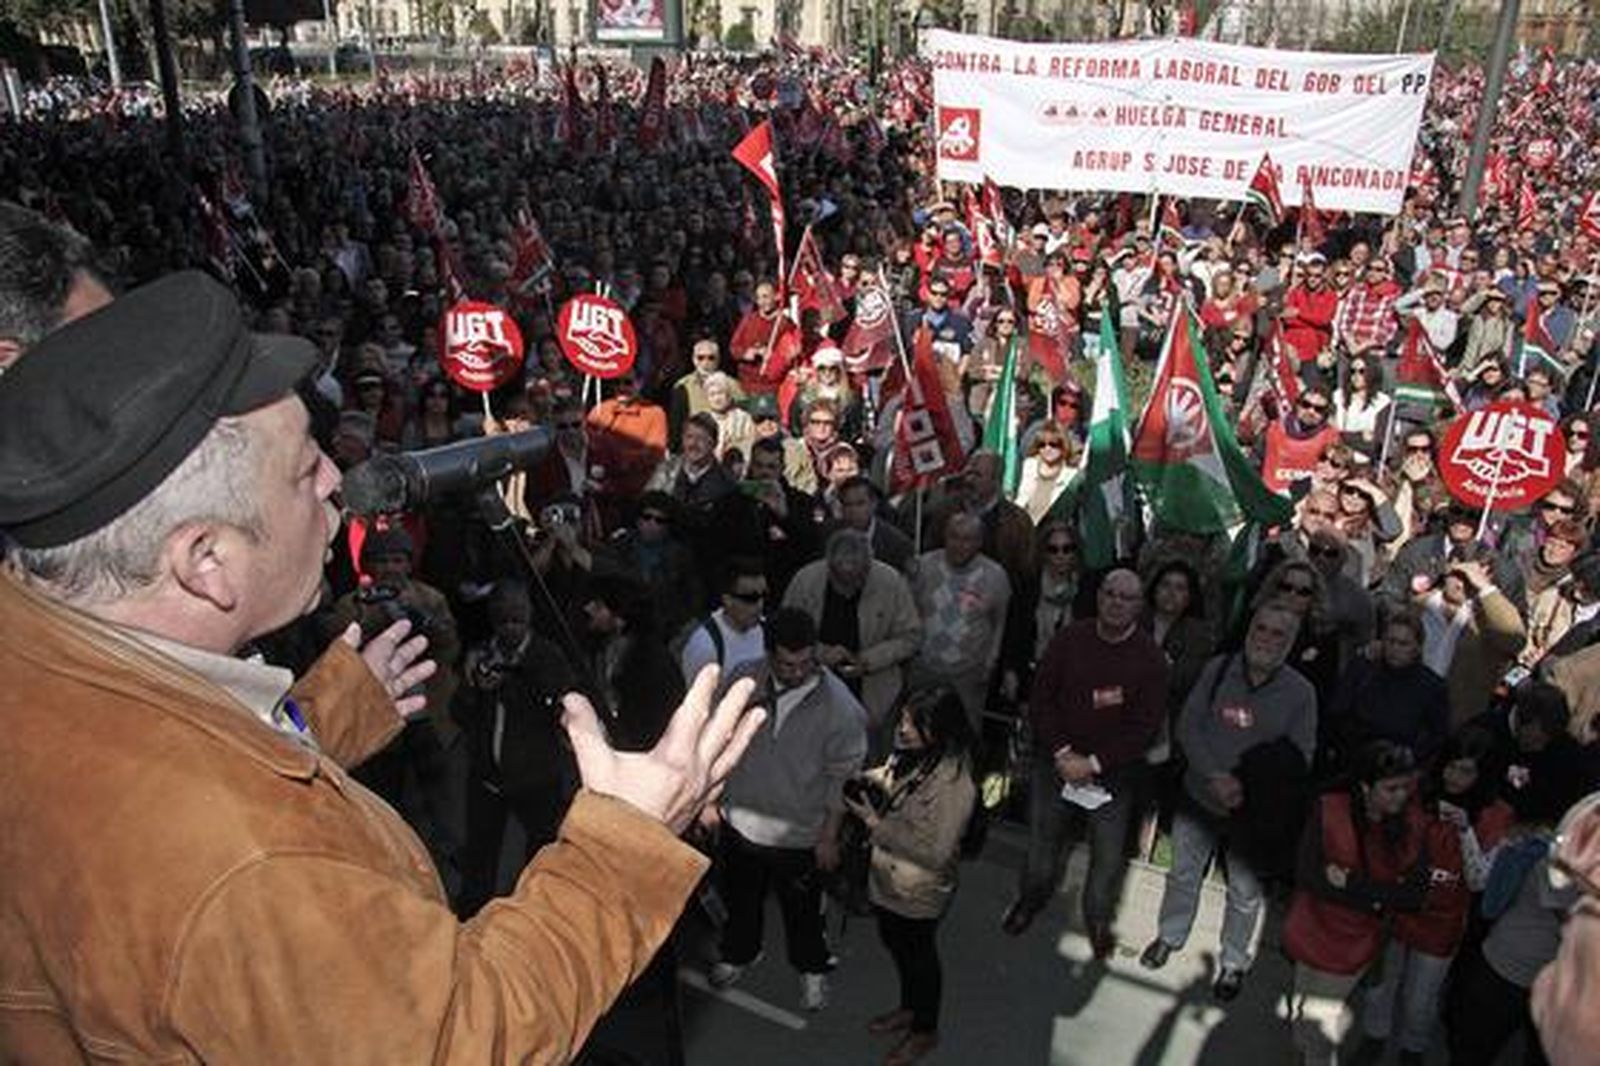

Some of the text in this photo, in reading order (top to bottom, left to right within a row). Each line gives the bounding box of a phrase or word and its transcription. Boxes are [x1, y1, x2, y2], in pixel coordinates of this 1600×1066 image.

[935, 51, 1426, 95] CONTRA LA REFORMA LABORAL DEL GOB DEL PP
[1115, 105, 1288, 138] HUELGA GENERAL
[1073, 150, 1132, 171] AGRUP
[1144, 153, 1155, 172] S
[1163, 155, 1212, 177] JOSE
[1223, 160, 1249, 181] DE
[1296, 165, 1404, 189] RINCONADA
[446, 311, 504, 345] UGT
[571, 299, 624, 339] UGT
[1460, 410, 1556, 458] UGT
